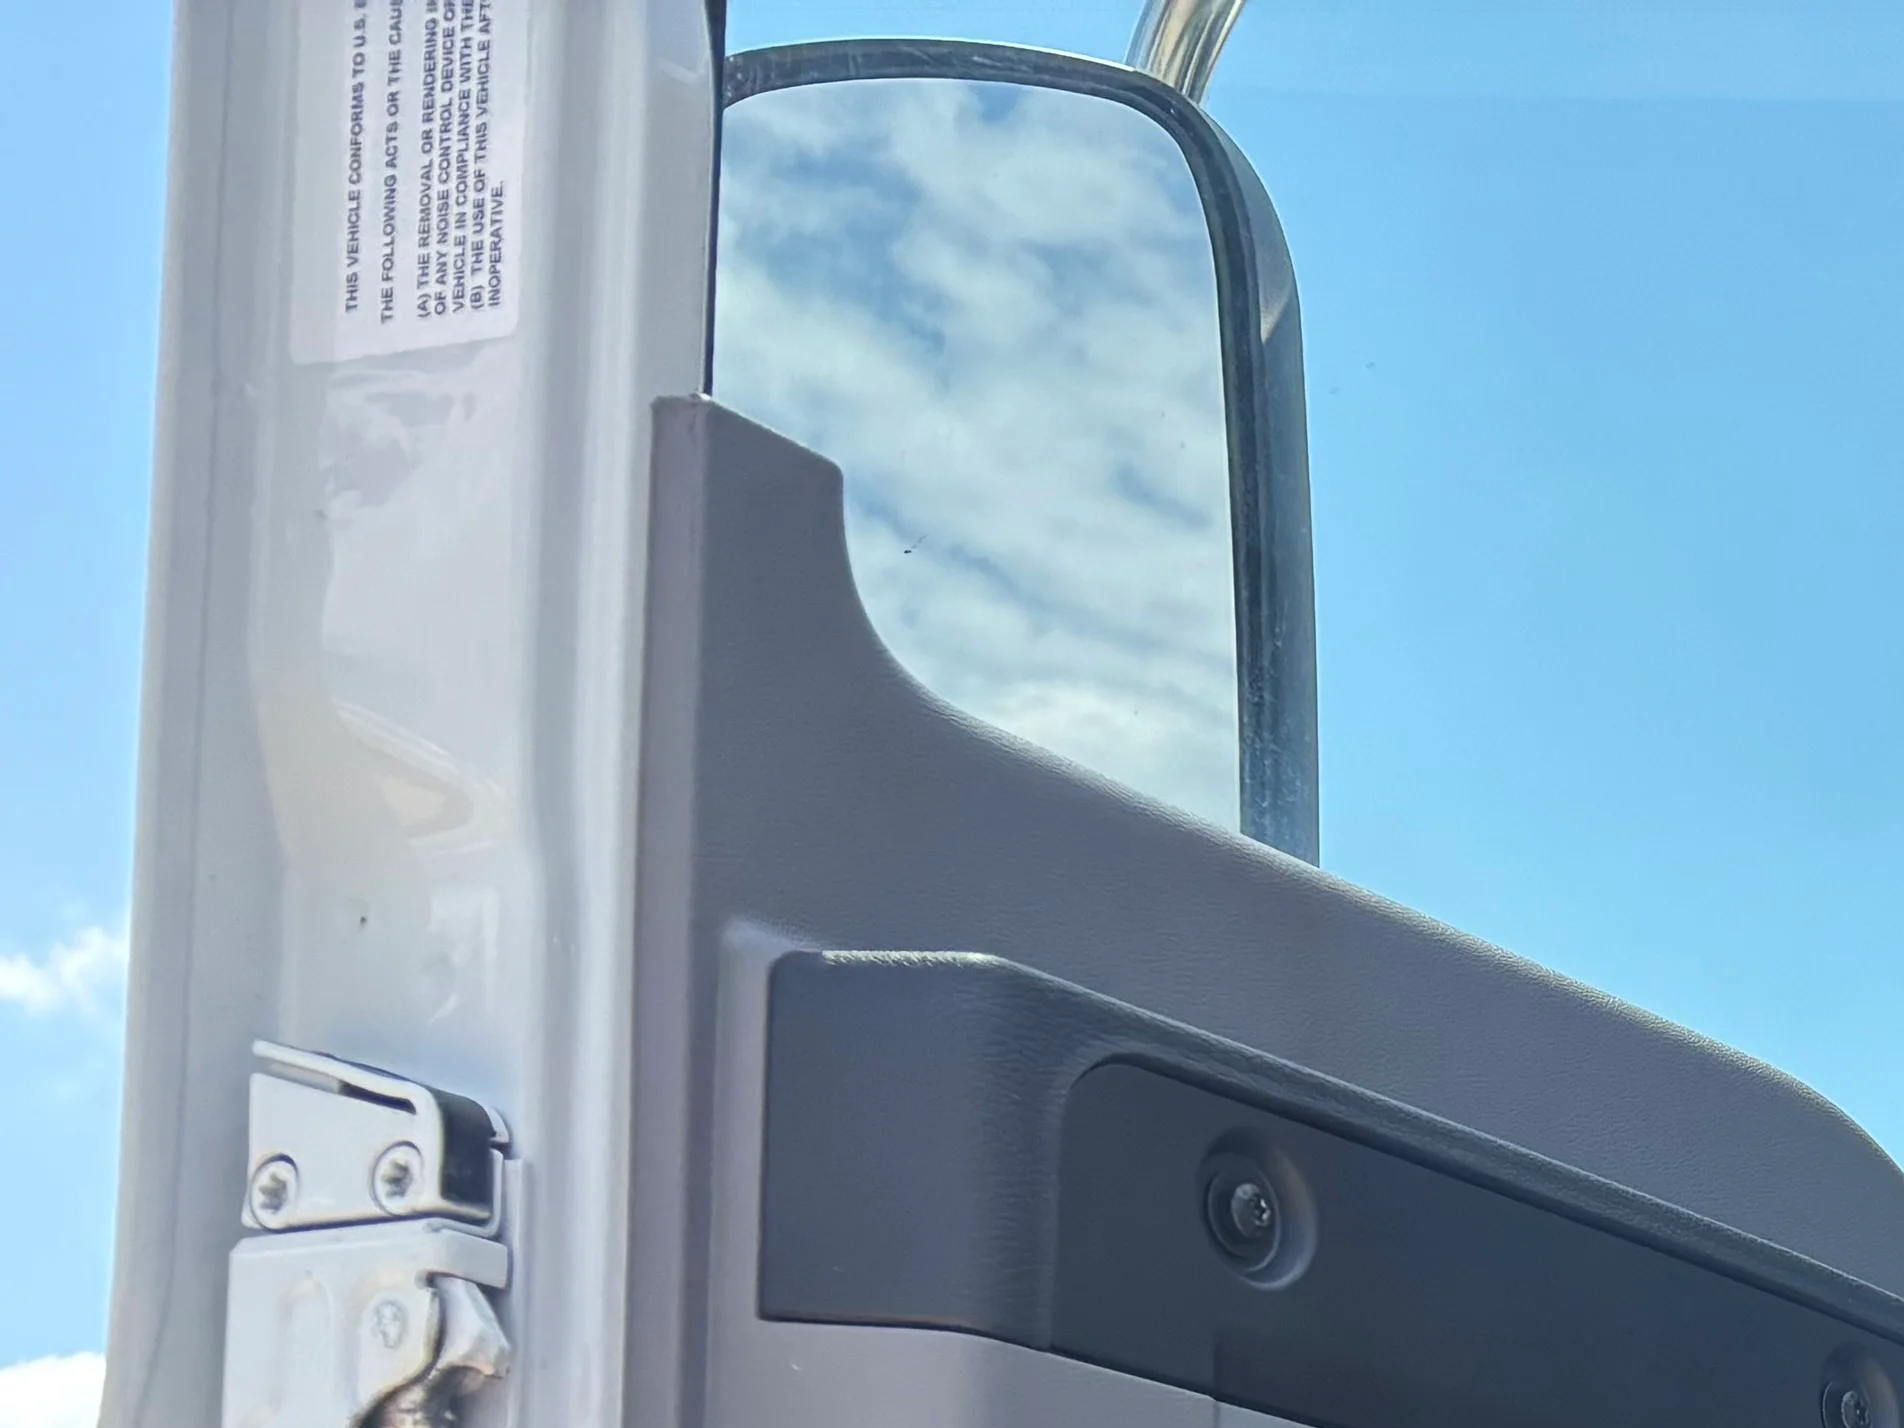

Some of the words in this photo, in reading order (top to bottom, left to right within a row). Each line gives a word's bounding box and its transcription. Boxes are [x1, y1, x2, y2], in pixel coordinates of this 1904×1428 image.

[352, 52, 365, 78] TO
[387, 49, 400, 86] THE
[422, 17, 439, 124] RENDERING
[441, 26, 455, 93] DEVICE
[459, 37, 472, 83] WITH
[476, 40, 490, 118] VEHICLE
[386, 91, 399, 117] OR
[349, 82, 364, 185] CONFORMS
[385, 121, 398, 168] ACTS
[421, 128, 433, 154] OR
[438, 97, 453, 184] CONTROL
[455, 88, 471, 207] COMPLIANCE
[474, 121, 488, 164] THIS
[473, 169, 486, 193] OF
[418, 159, 433, 248] REMOVAL
[436, 189, 449, 244] NOISE
[454, 211, 467, 229] IN
[472, 197, 485, 234] USE
[346, 189, 361, 267] VEHICLE
[382, 174, 397, 282] FOLLOWING
[488, 181, 504, 307] INOPERATIVE.
[417, 252, 430, 290] THE
[435, 250, 448, 285] ANY
[452, 235, 466, 313] VEHICLE
[471, 239, 484, 276] THE
[346, 272, 358, 313] THIS
[381, 287, 393, 324] THE
[417, 293, 432, 318] (A)
[434, 291, 447, 315] OF
[470, 284, 485, 310] (B)
